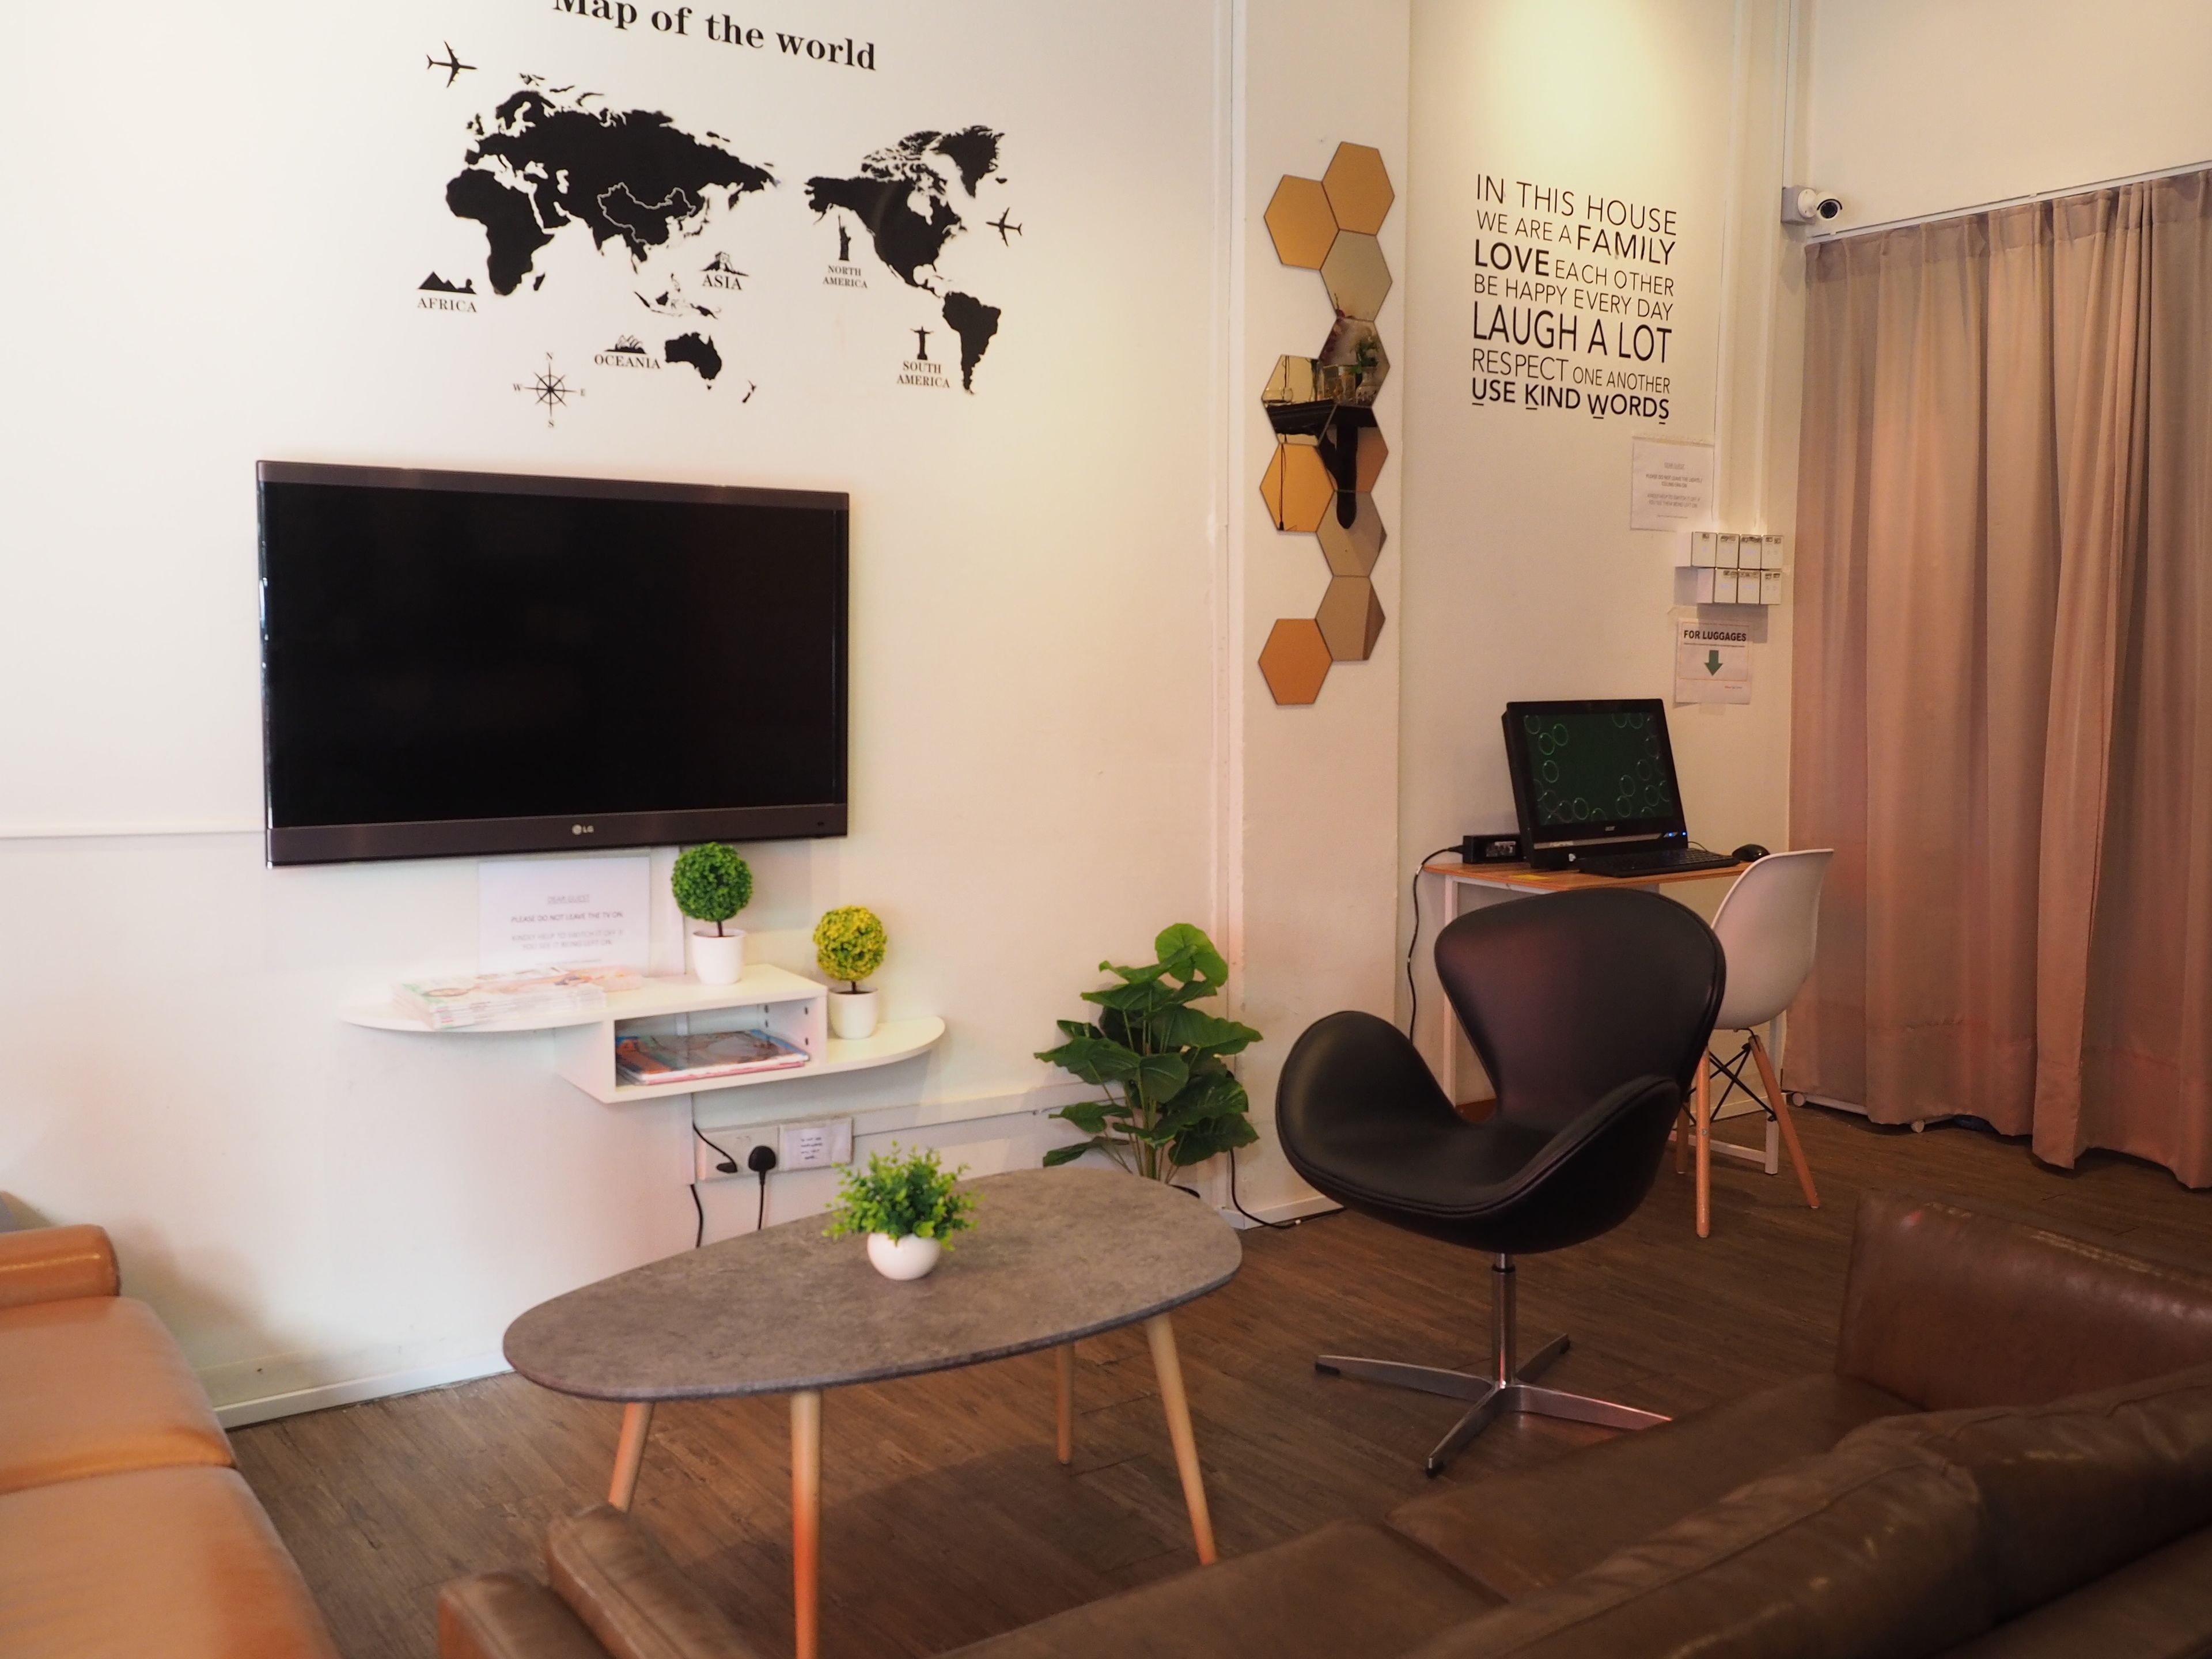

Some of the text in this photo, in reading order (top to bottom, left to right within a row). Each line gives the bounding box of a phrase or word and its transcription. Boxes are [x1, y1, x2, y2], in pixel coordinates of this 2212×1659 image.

[651, 7, 692, 35] of
[705, 14, 764, 48] the
[775, 32, 876, 70] world
[1477, 174, 1677, 236] IN THIS HOUSE
[1477, 210, 1676, 265] WE ARE A FAMILY
[828, 265, 862, 276] NORTH
[1475, 239, 1674, 296] LOVE EACH OTHER
[702, 274, 743, 291] ASIA
[823, 276, 868, 289] AMERICA
[416, 297, 478, 313] AFRICA
[1475, 274, 1673, 321] BE HAPPY EVERY DAY
[1474, 301, 1672, 363] LAUGH A LOT
[546, 352, 554, 360] N
[594, 354, 661, 369] OCEANIA
[903, 361, 941, 374] SOUTH
[1472, 349, 1670, 393] RESPECT ONE ANOTHER
[513, 384, 522, 392] W
[897, 374, 950, 388] AMERICA
[580, 388, 586, 396] E
[1472, 377, 1669, 419] USE KIND WORDS
[1684, 630, 1746, 641] FOR LUGGAGES
